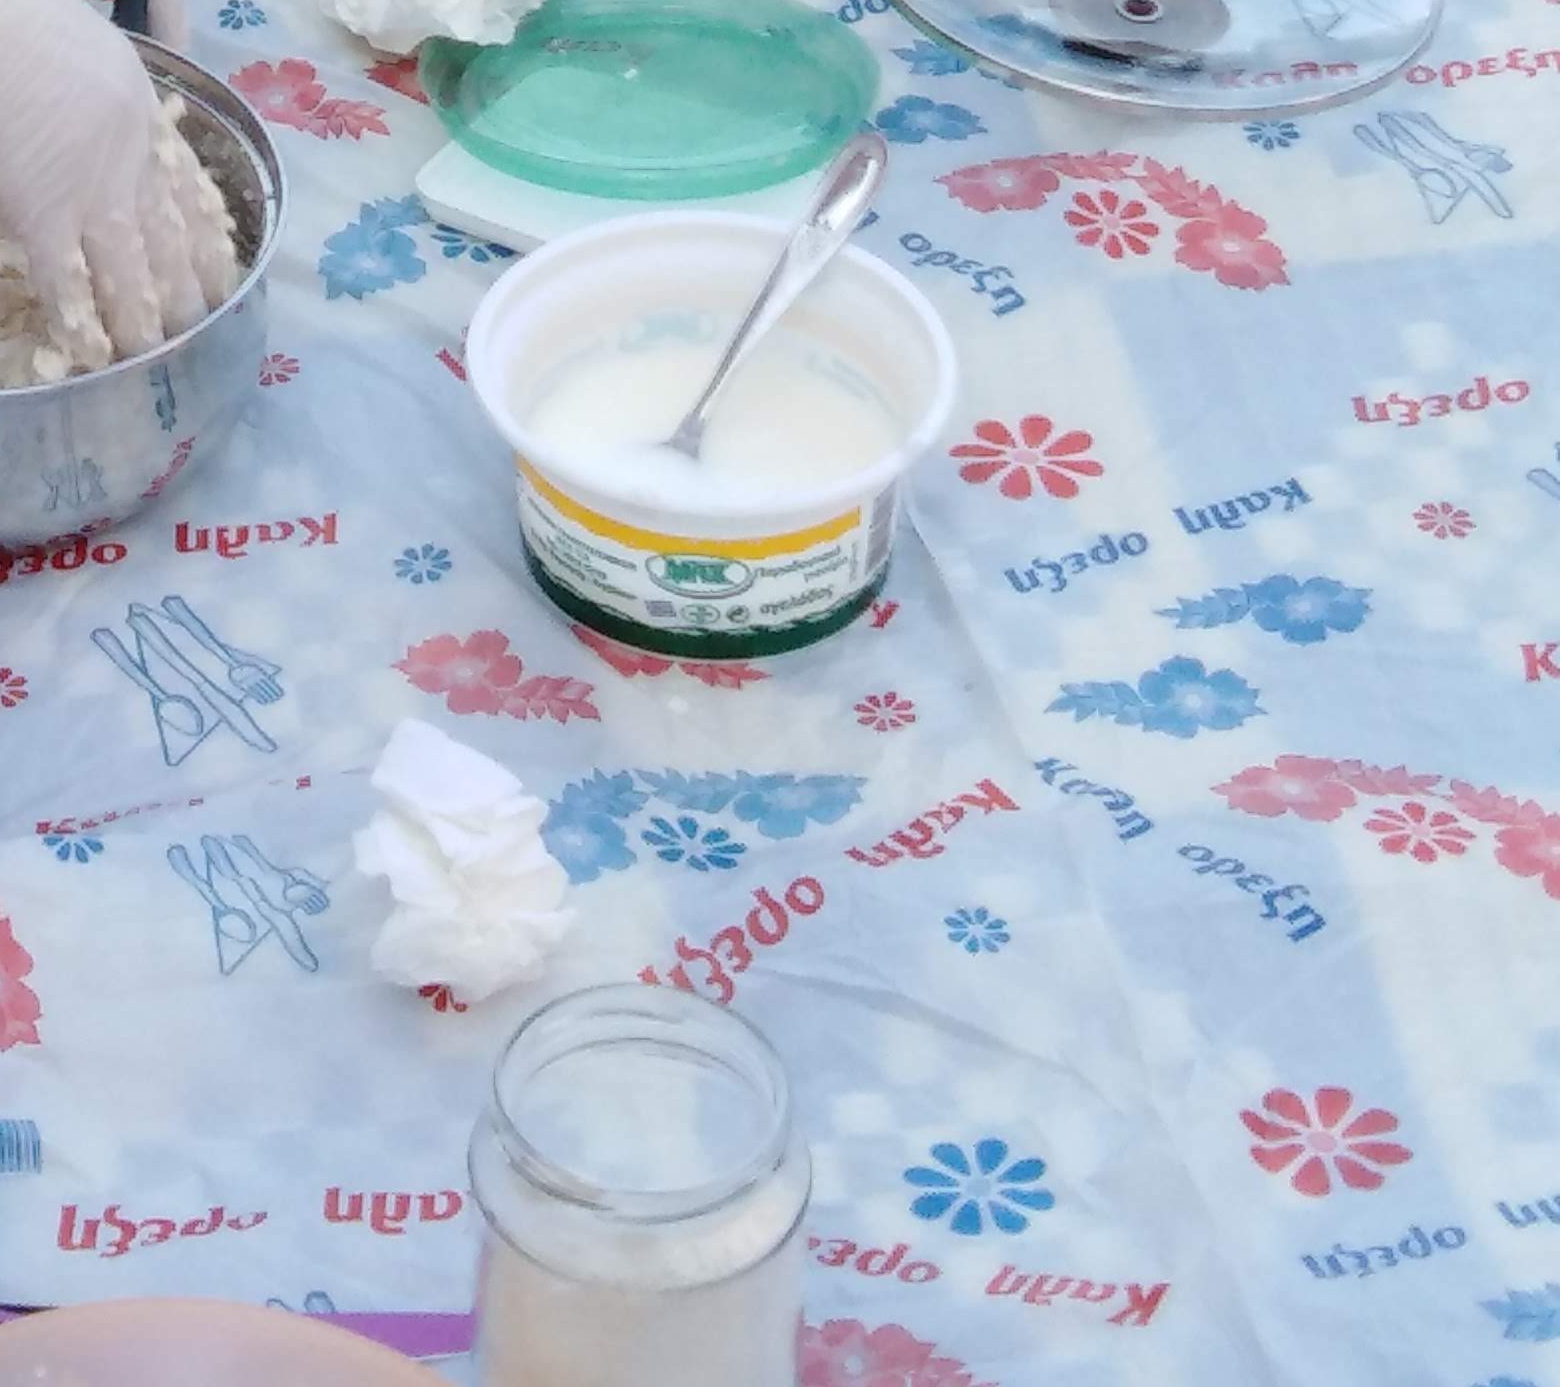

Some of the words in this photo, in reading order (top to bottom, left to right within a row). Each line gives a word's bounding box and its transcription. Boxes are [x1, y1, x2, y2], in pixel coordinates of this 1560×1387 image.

[1172, 477, 1312, 535] Καλη
[175, 513, 338, 560] Καλη
[845, 778, 1020, 868] Καλη
[323, 1187, 463, 1234] αλη
[985, 1263, 1170, 1327] Καλη
